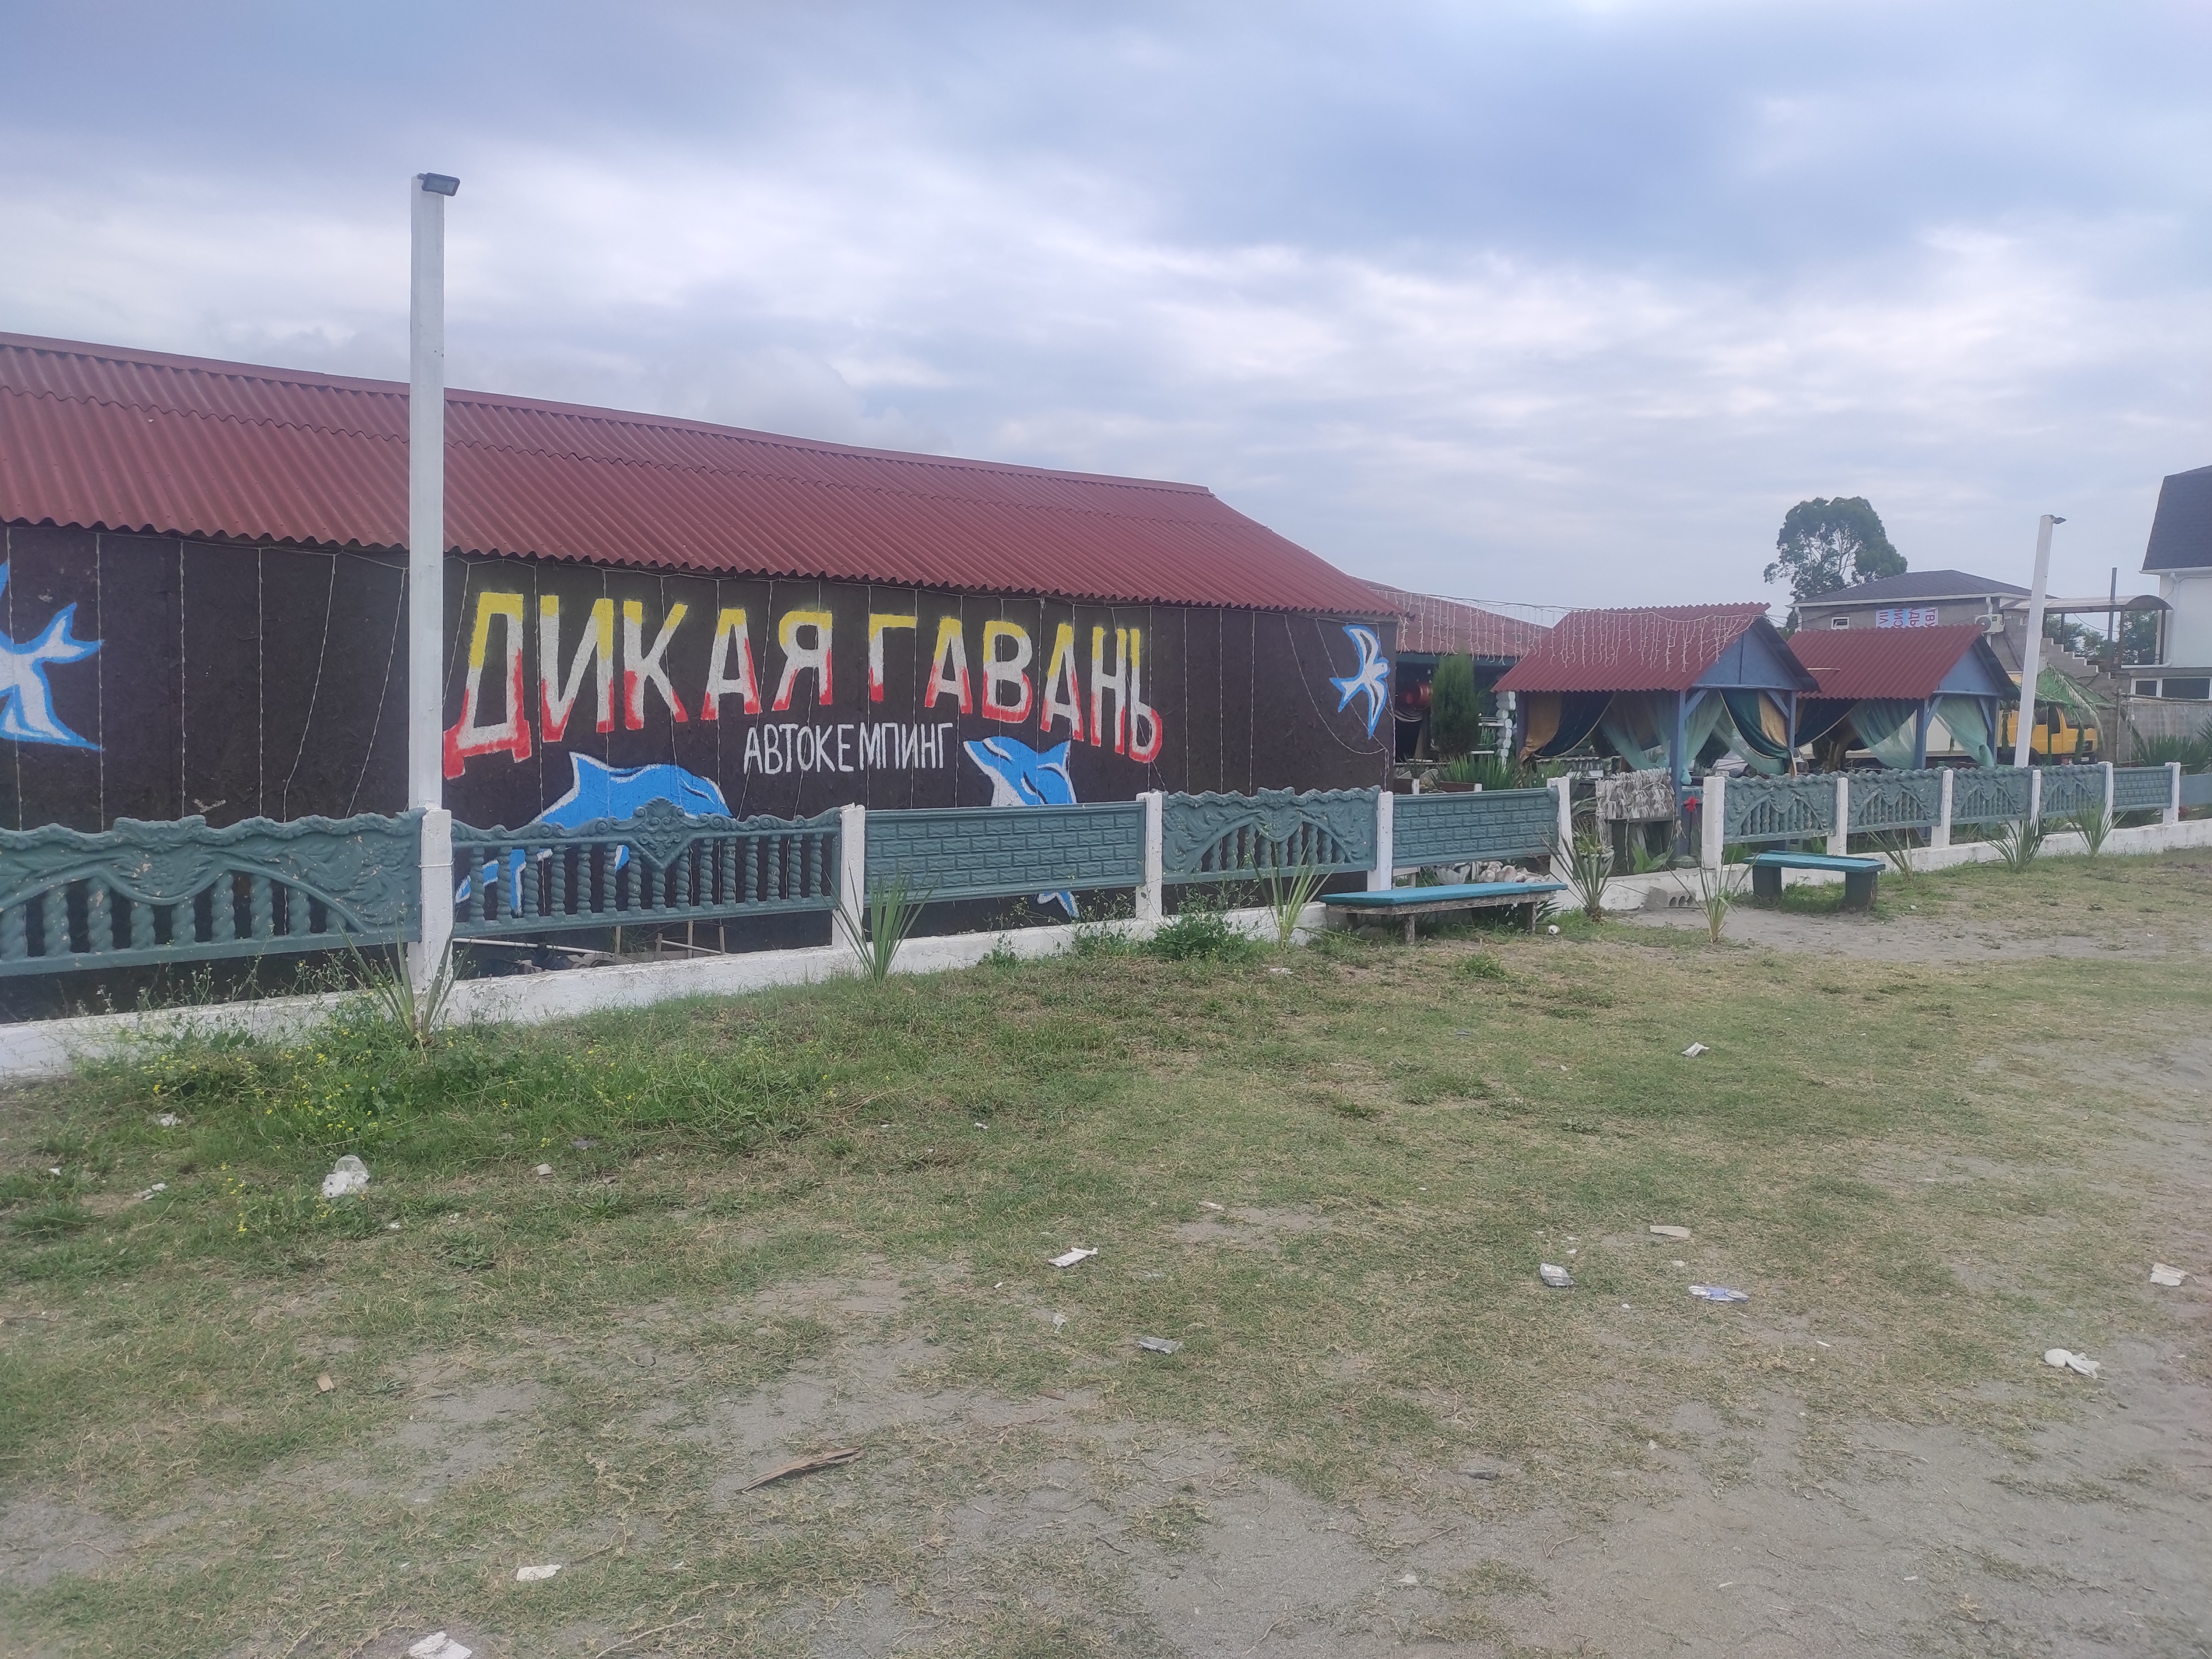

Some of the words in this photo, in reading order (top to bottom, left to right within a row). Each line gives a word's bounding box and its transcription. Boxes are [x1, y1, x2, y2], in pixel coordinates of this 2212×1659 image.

[444, 592, 832, 779] ДИКАЯ
[869, 614, 1163, 764] ГАВАНЬ
[743, 722, 953, 775] АВТОКЕМПИНГ
